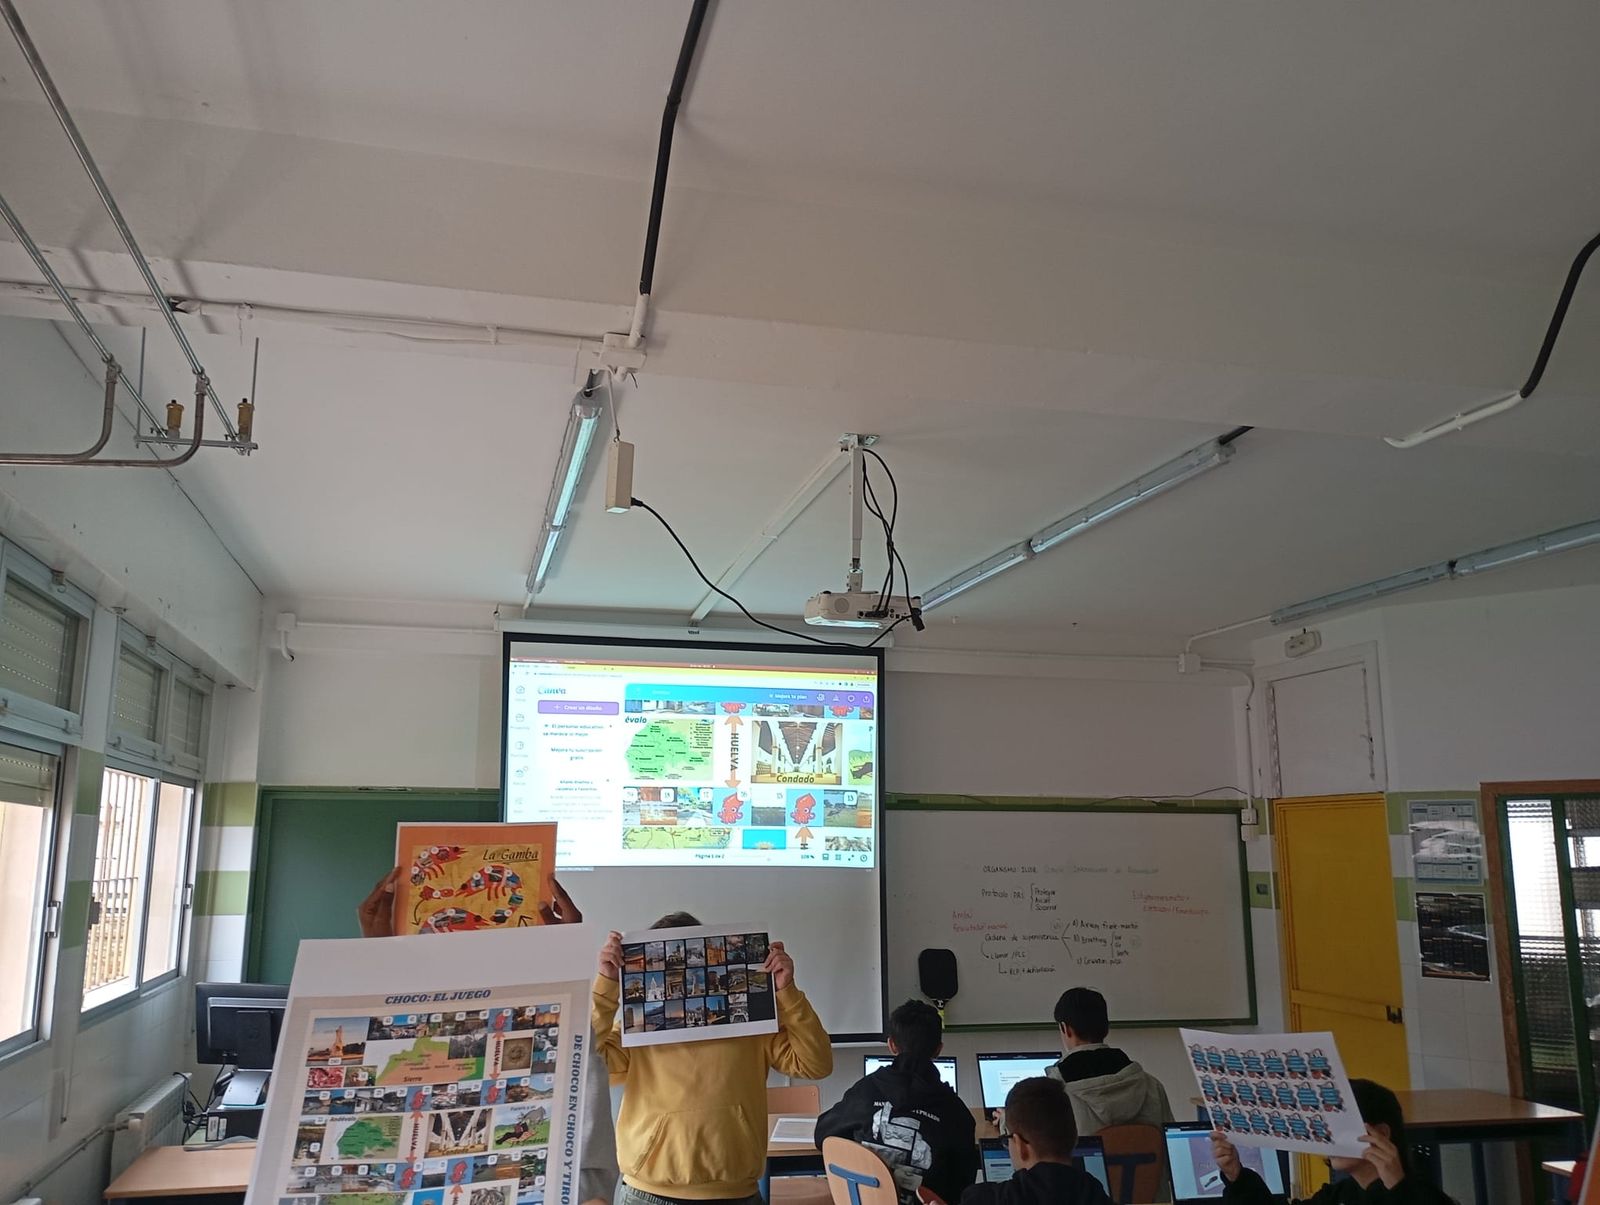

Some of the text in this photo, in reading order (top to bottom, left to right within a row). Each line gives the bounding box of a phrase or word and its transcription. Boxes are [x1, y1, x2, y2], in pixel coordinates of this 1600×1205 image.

[730, 732, 739, 771] HUELVA
[776, 774, 815, 784] Condado
[482, 847, 539, 861] La Gamba
[385, 989, 492, 1005] CHOCO: EL JUEGO
[560, 1034, 583, 1205] DE CHOCO EN CHOCO Y TIRO
